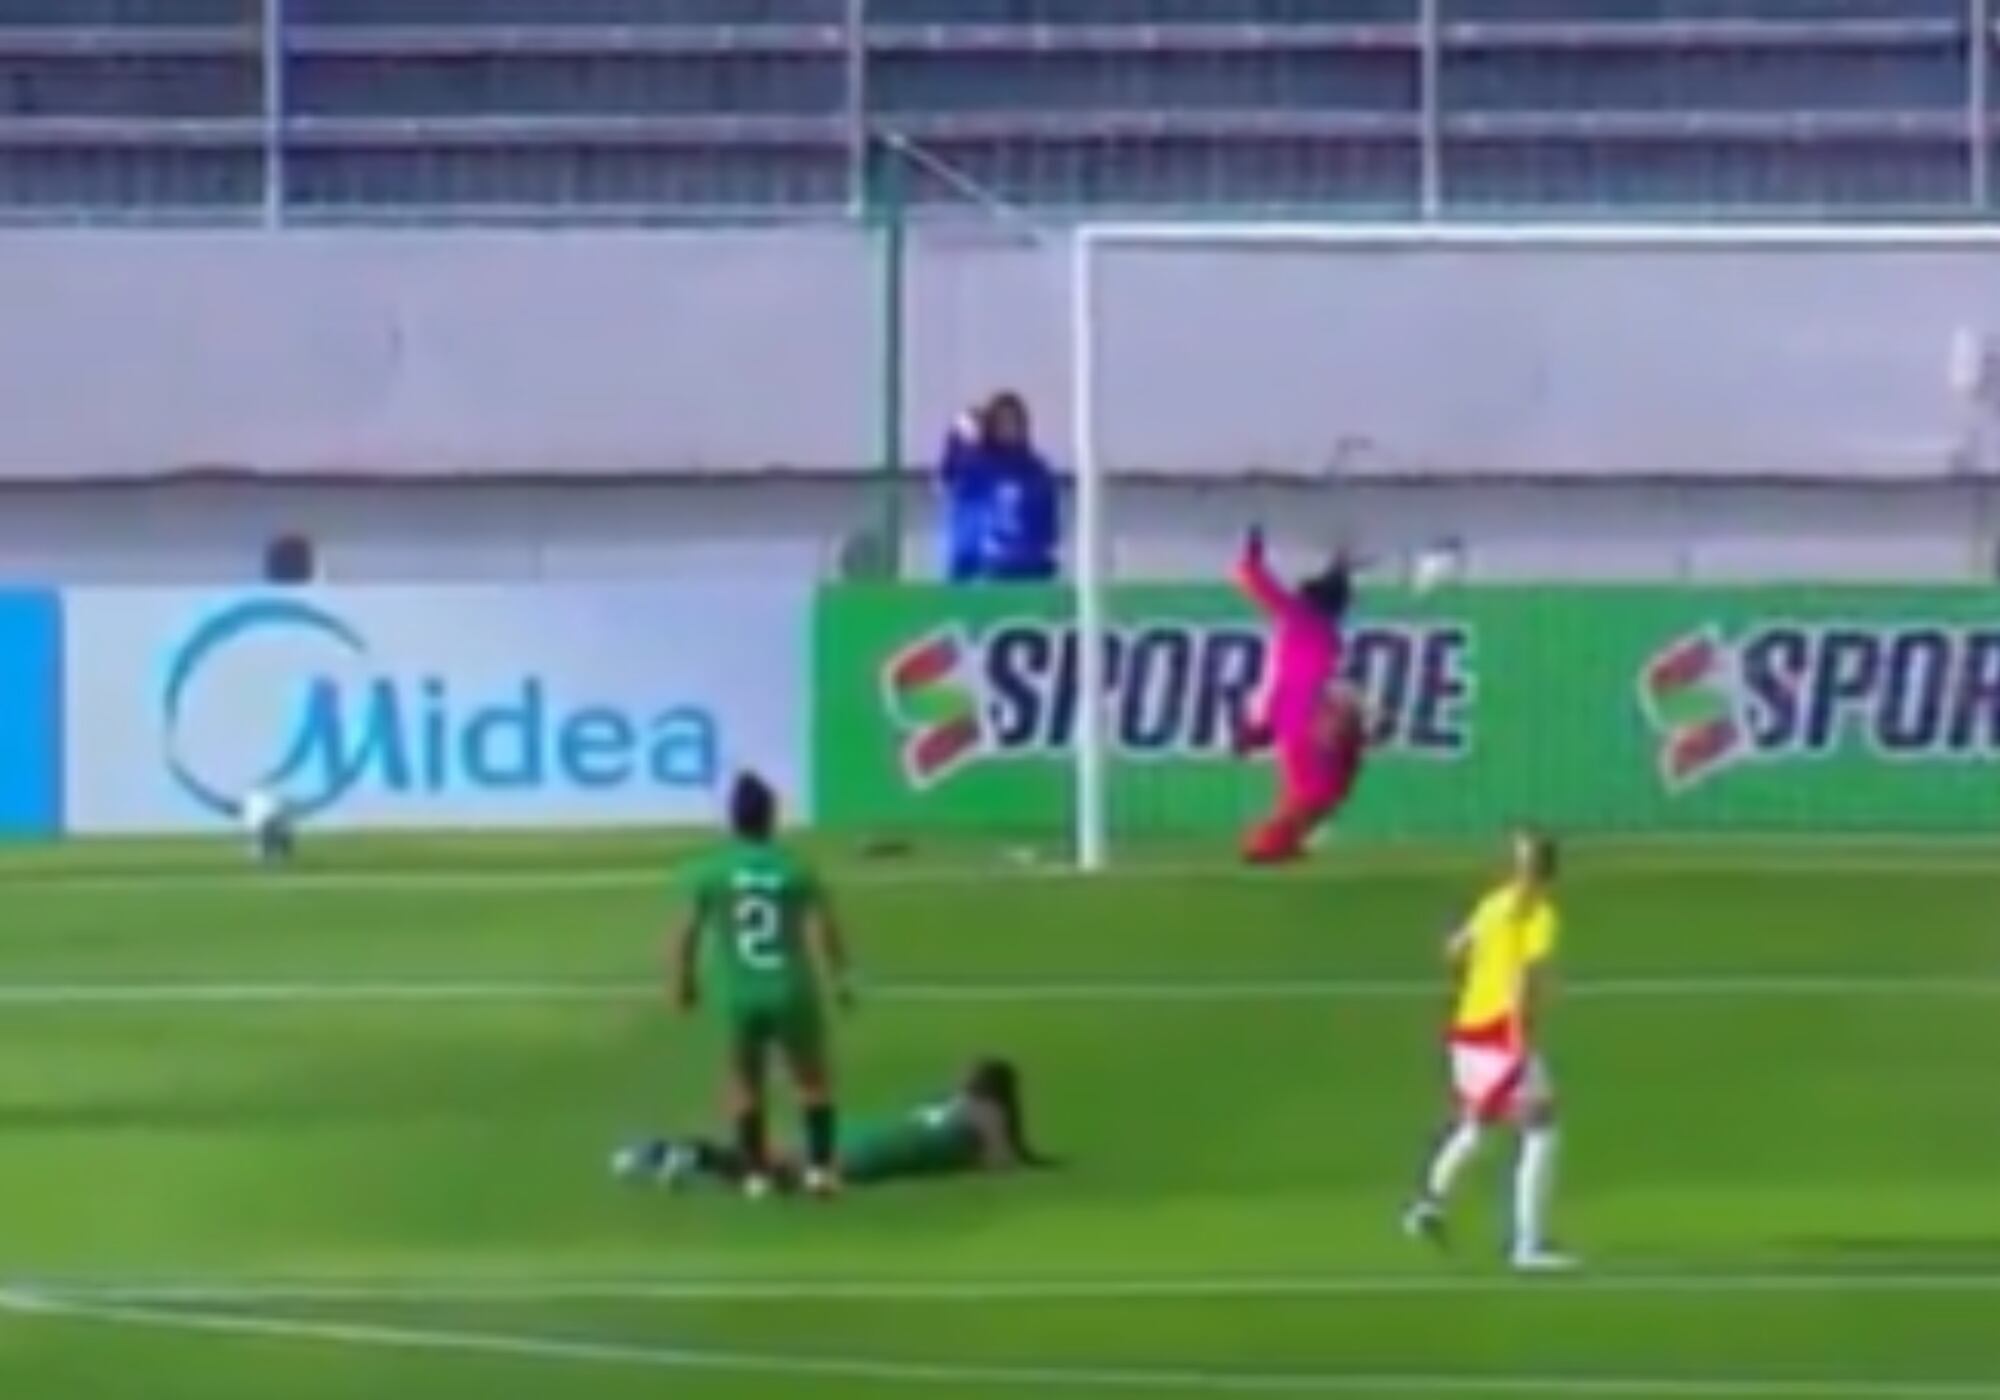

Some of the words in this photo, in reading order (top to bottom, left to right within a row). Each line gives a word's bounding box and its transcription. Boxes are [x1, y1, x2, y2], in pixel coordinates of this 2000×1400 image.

[258, 676, 721, 793] Midea
[984, 627, 1468, 750] SPORDE
[734, 895, 784, 970] 2
